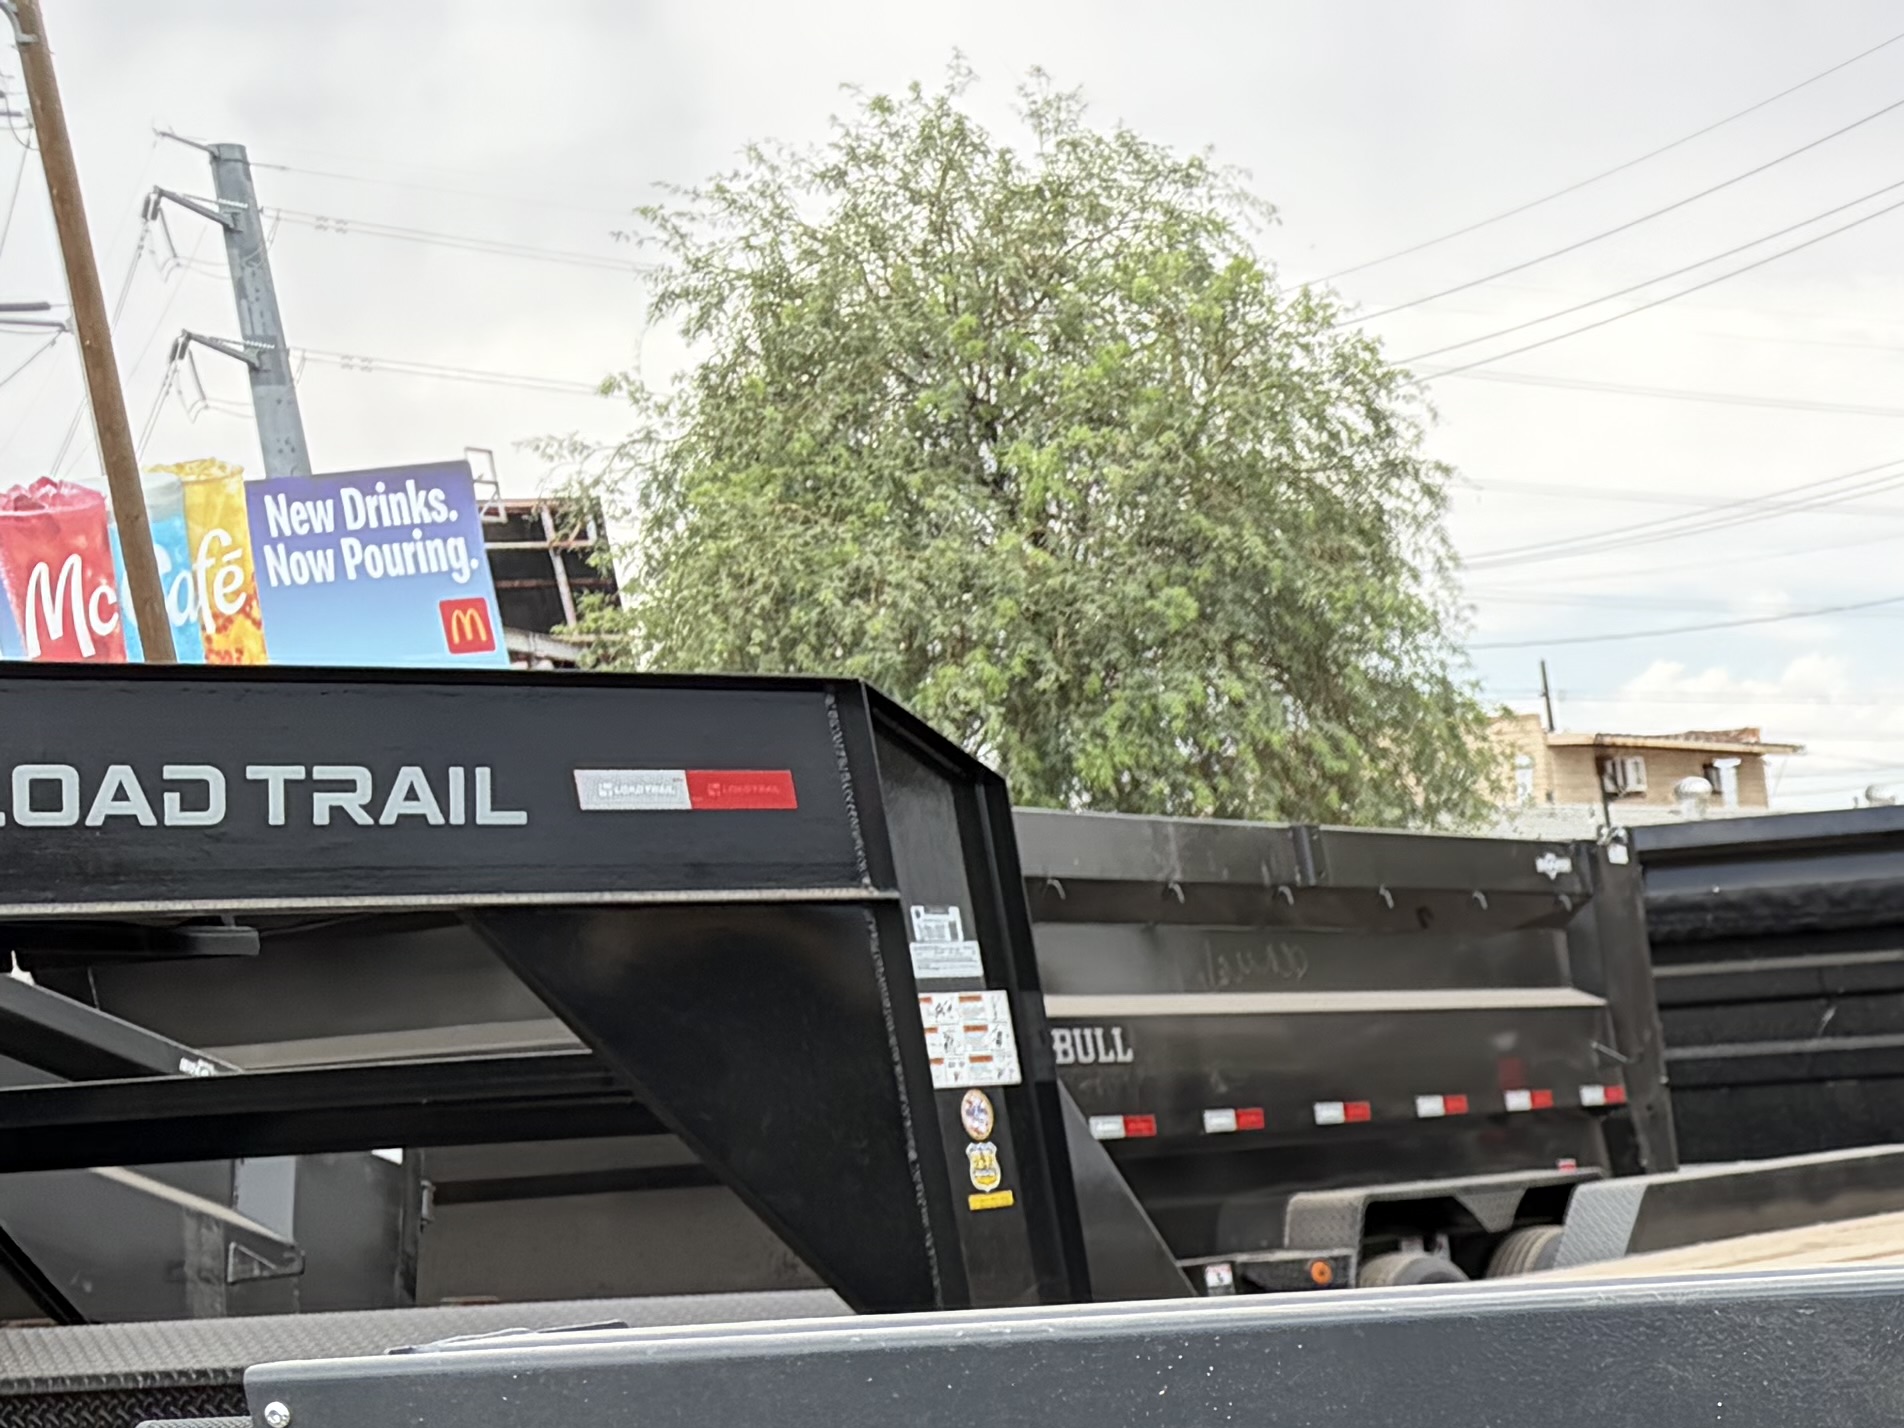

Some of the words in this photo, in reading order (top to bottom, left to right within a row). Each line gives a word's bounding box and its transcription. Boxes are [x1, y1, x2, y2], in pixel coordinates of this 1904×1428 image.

[264, 491, 334, 537] New
[340, 479, 458, 531] Drinks.
[264, 541, 335, 587] Now
[341, 530, 479, 584] Pouring.
[0, 764, 226, 827] OAD
[246, 765, 528, 825] TRAIL
[1051, 1027, 1134, 1064] BULL
